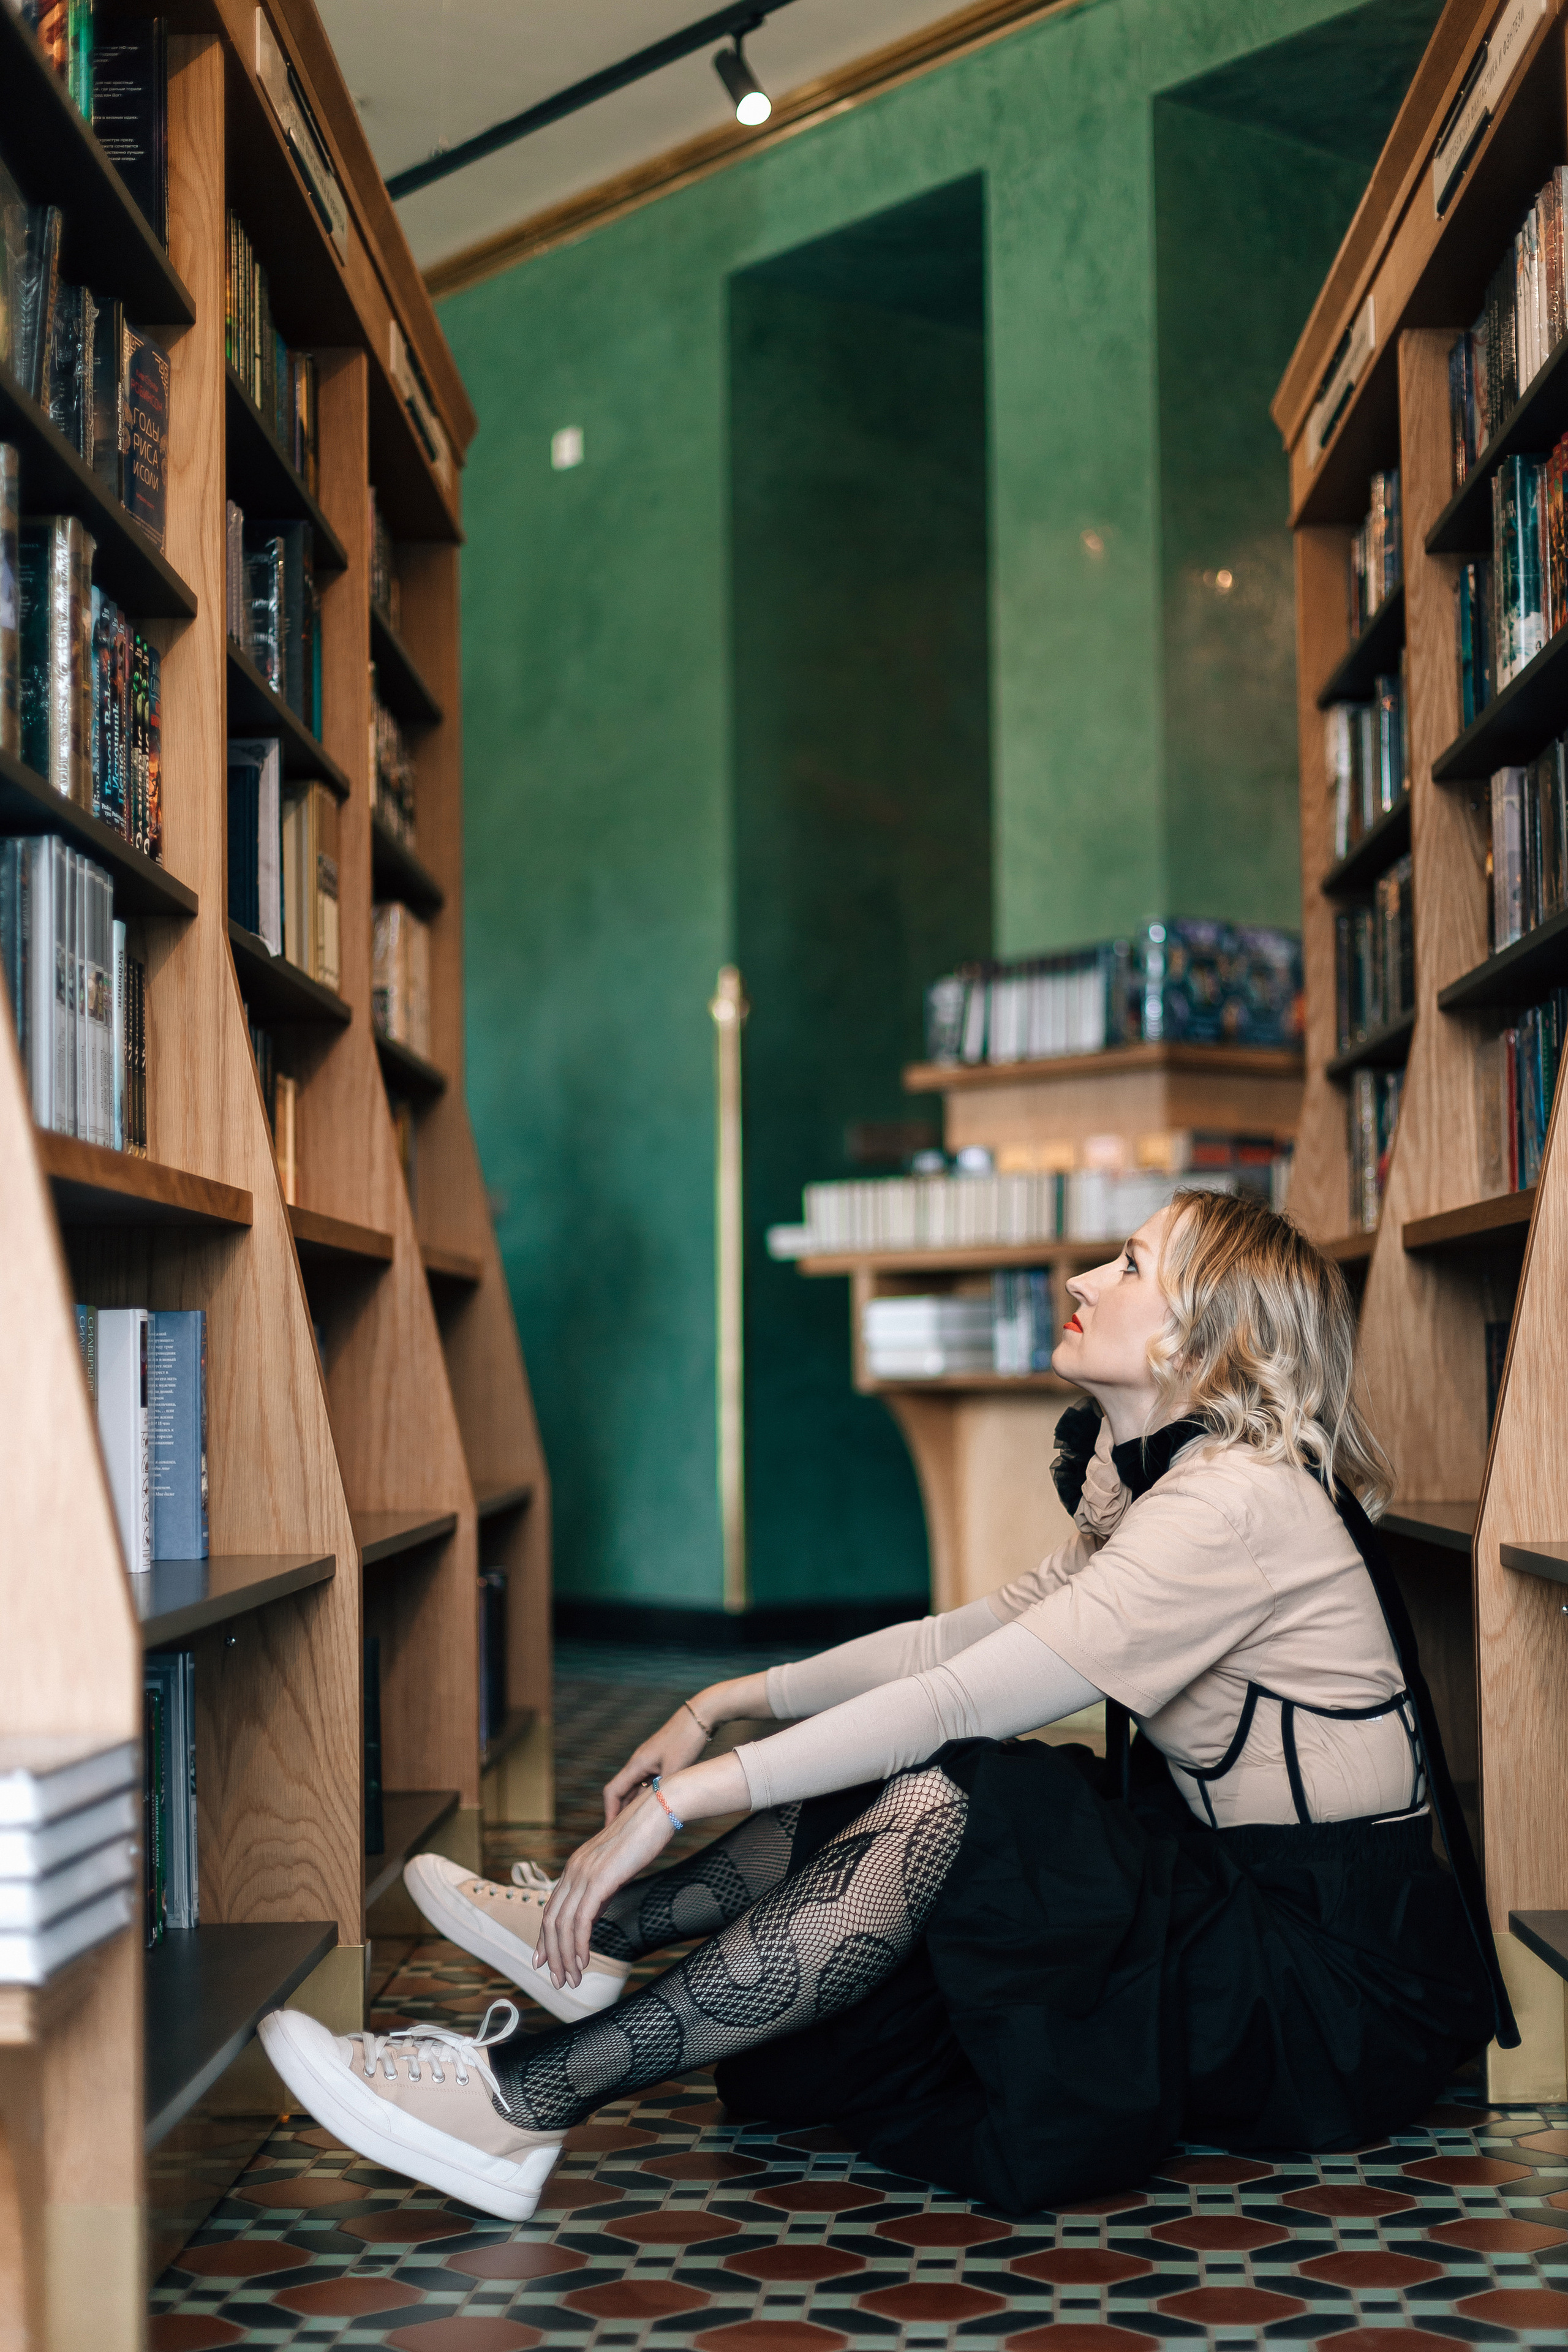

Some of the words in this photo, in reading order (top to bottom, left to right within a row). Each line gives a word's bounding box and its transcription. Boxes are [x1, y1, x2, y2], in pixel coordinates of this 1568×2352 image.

[1471, 62, 1498, 121] ФАНТАСТИКА
[1502, 4, 1525, 56] ФЭНТЕЗИ
[134, 407, 159, 443] ГОДЫ
[134, 432, 159, 469] РИСА
[133, 459, 139, 477] И
[140, 464, 159, 492] СОЛИ
